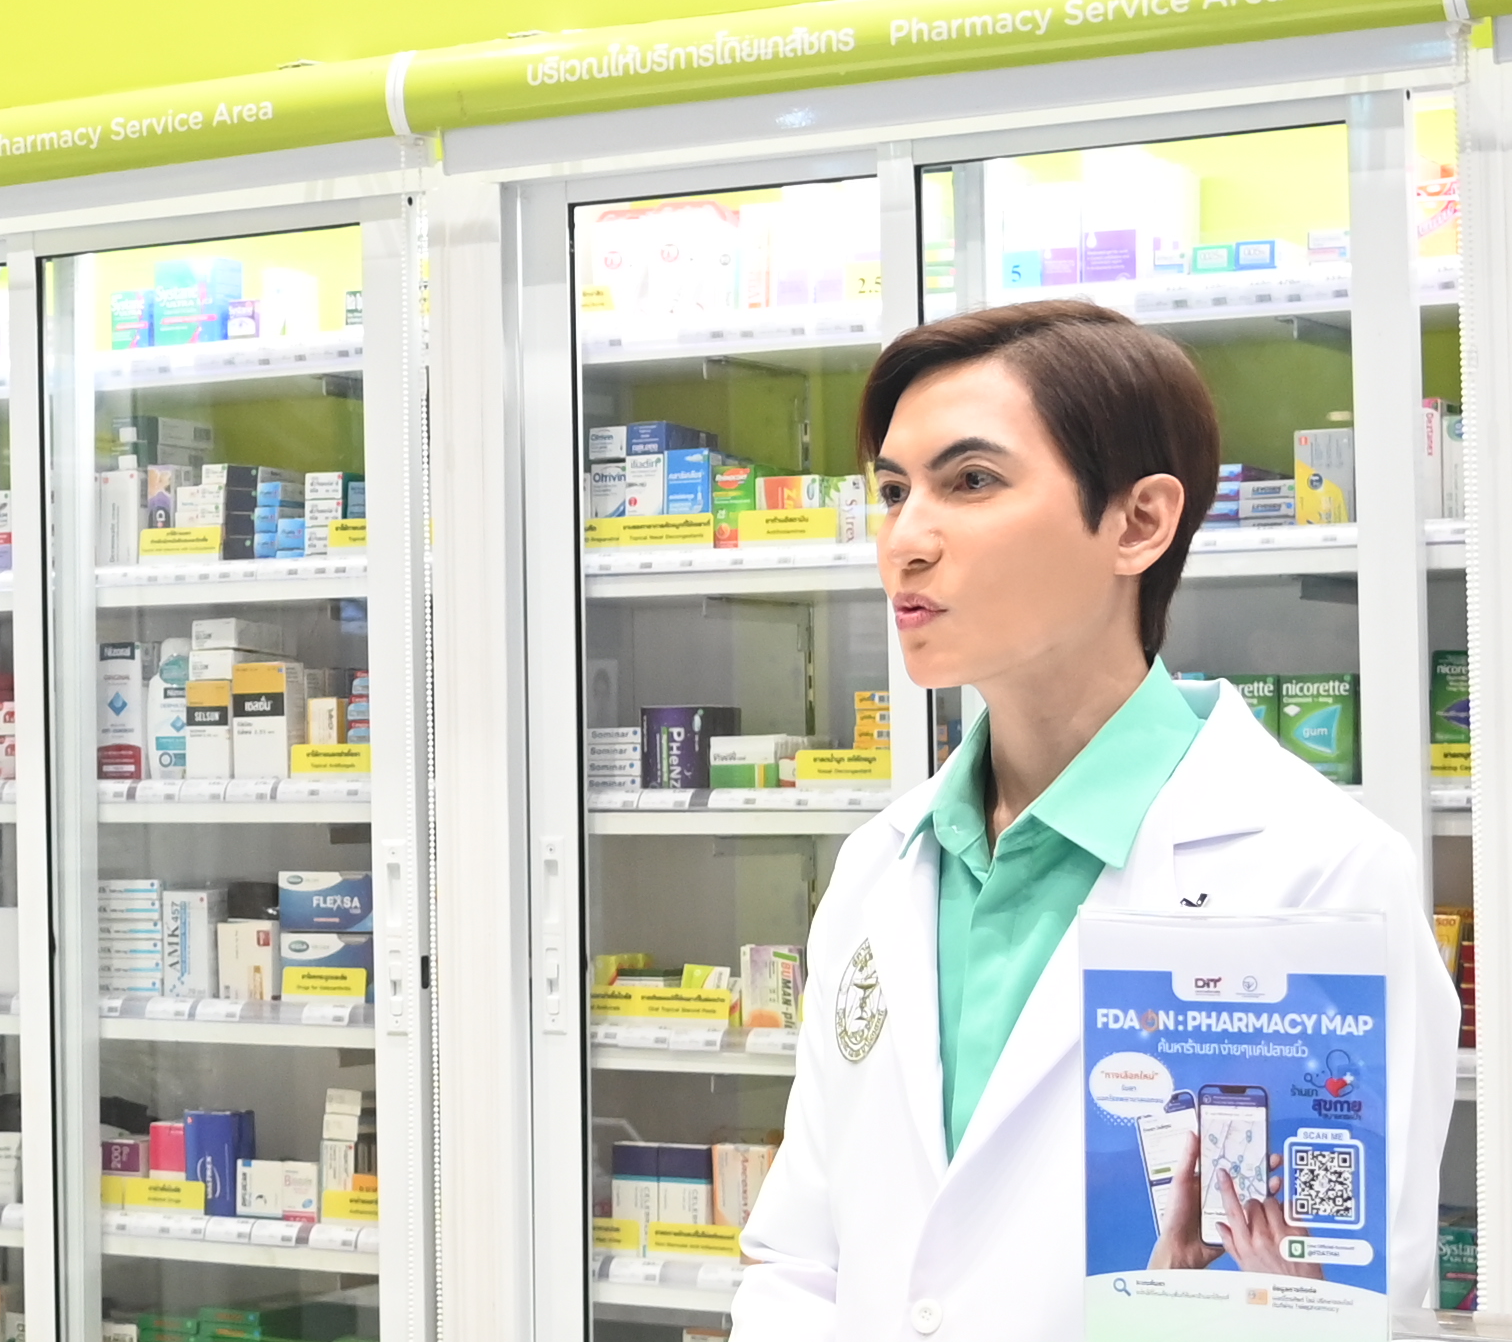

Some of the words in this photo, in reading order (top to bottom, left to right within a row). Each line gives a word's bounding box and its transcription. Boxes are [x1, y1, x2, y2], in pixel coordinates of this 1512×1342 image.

[889, 5, 1054, 47] Pharmacy
[110, 106, 204, 141] Service
[212, 100, 274, 126] Area
[1282, 679, 1351, 697] nicorette
[1302, 726, 1329, 741] gum
[1186, 1010, 1316, 1036] PHARMACY
[1320, 1013, 1374, 1037] MAP
